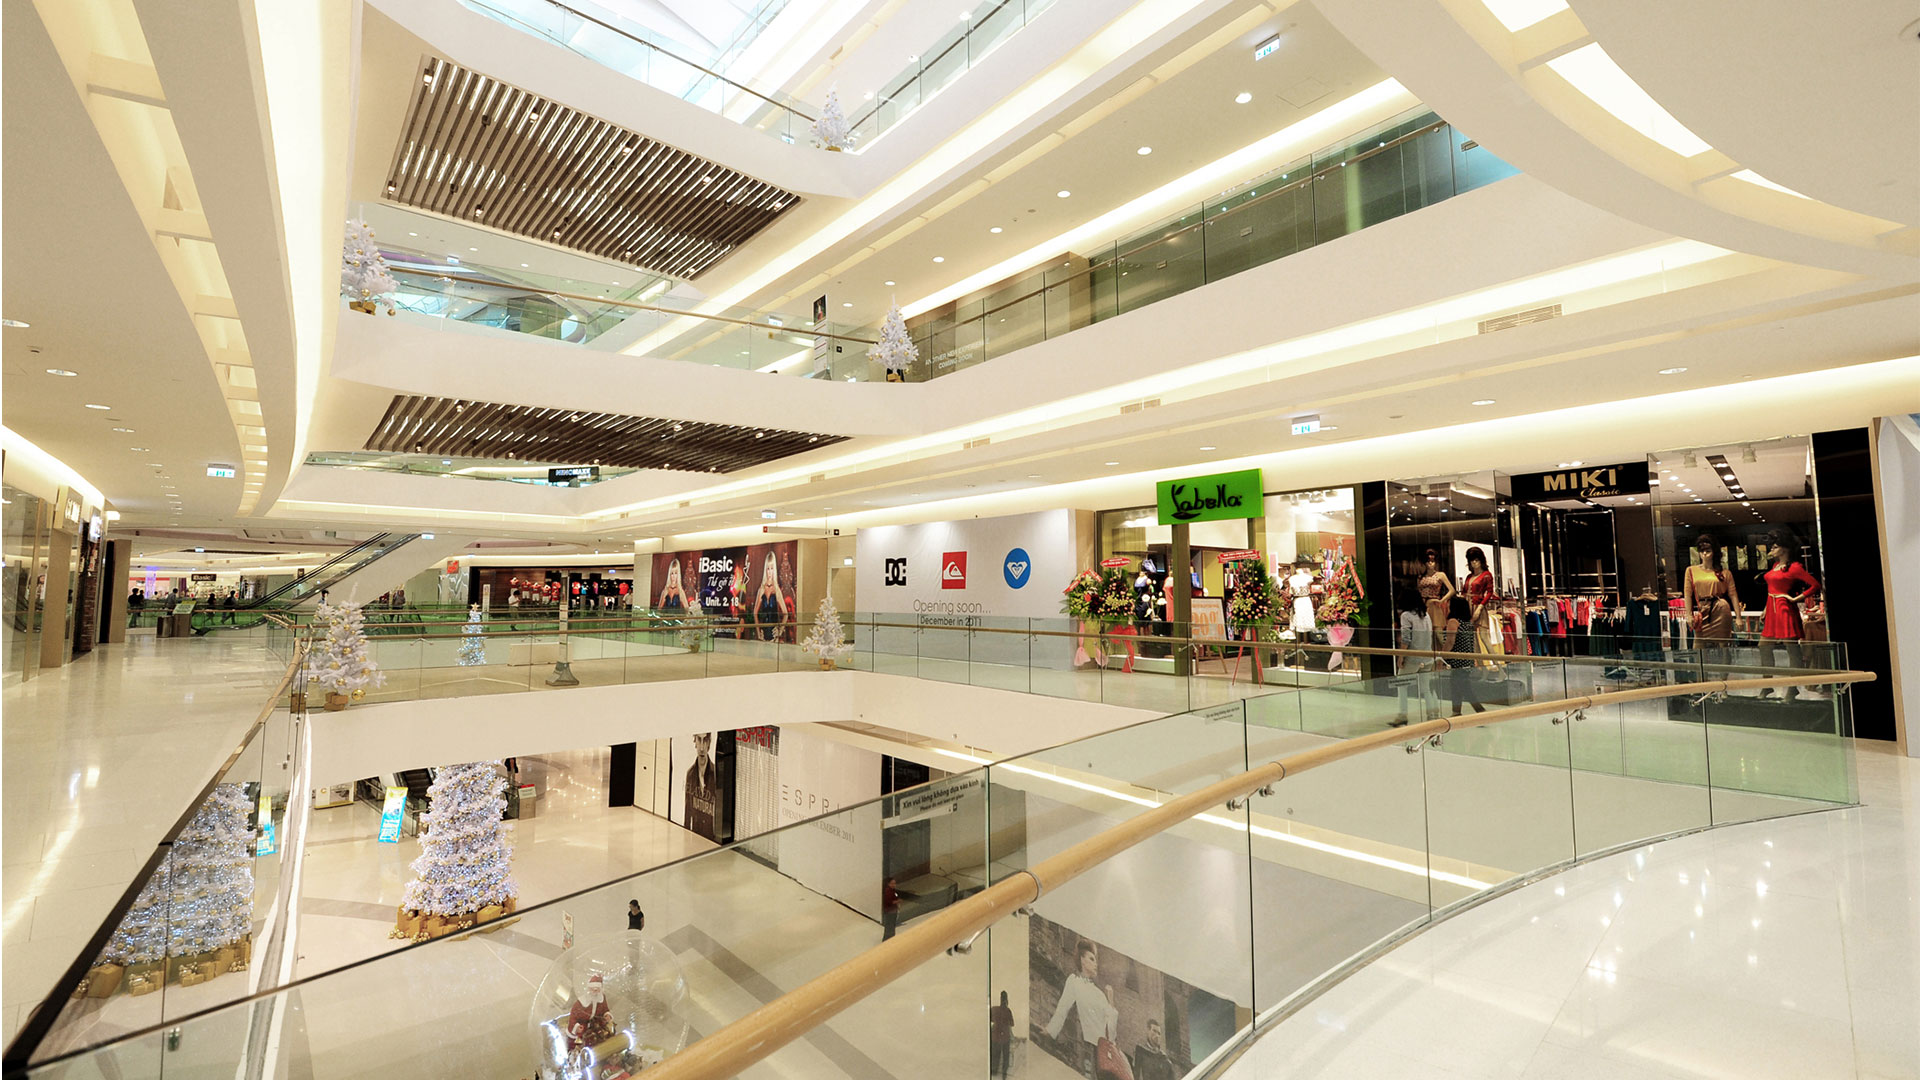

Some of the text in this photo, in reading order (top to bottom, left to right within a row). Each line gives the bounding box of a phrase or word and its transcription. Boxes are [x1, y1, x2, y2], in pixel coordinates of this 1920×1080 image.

[1543, 469, 1617, 491] MIKI
[1580, 487, 1620, 498] Classic
[698, 555, 733, 573] iBasic
[731, 597, 739, 607] 18
[913, 599, 991, 615] Opening soon...
[920, 615, 982, 627] December in 2011
[736, 727, 774, 748] ESPRIT
